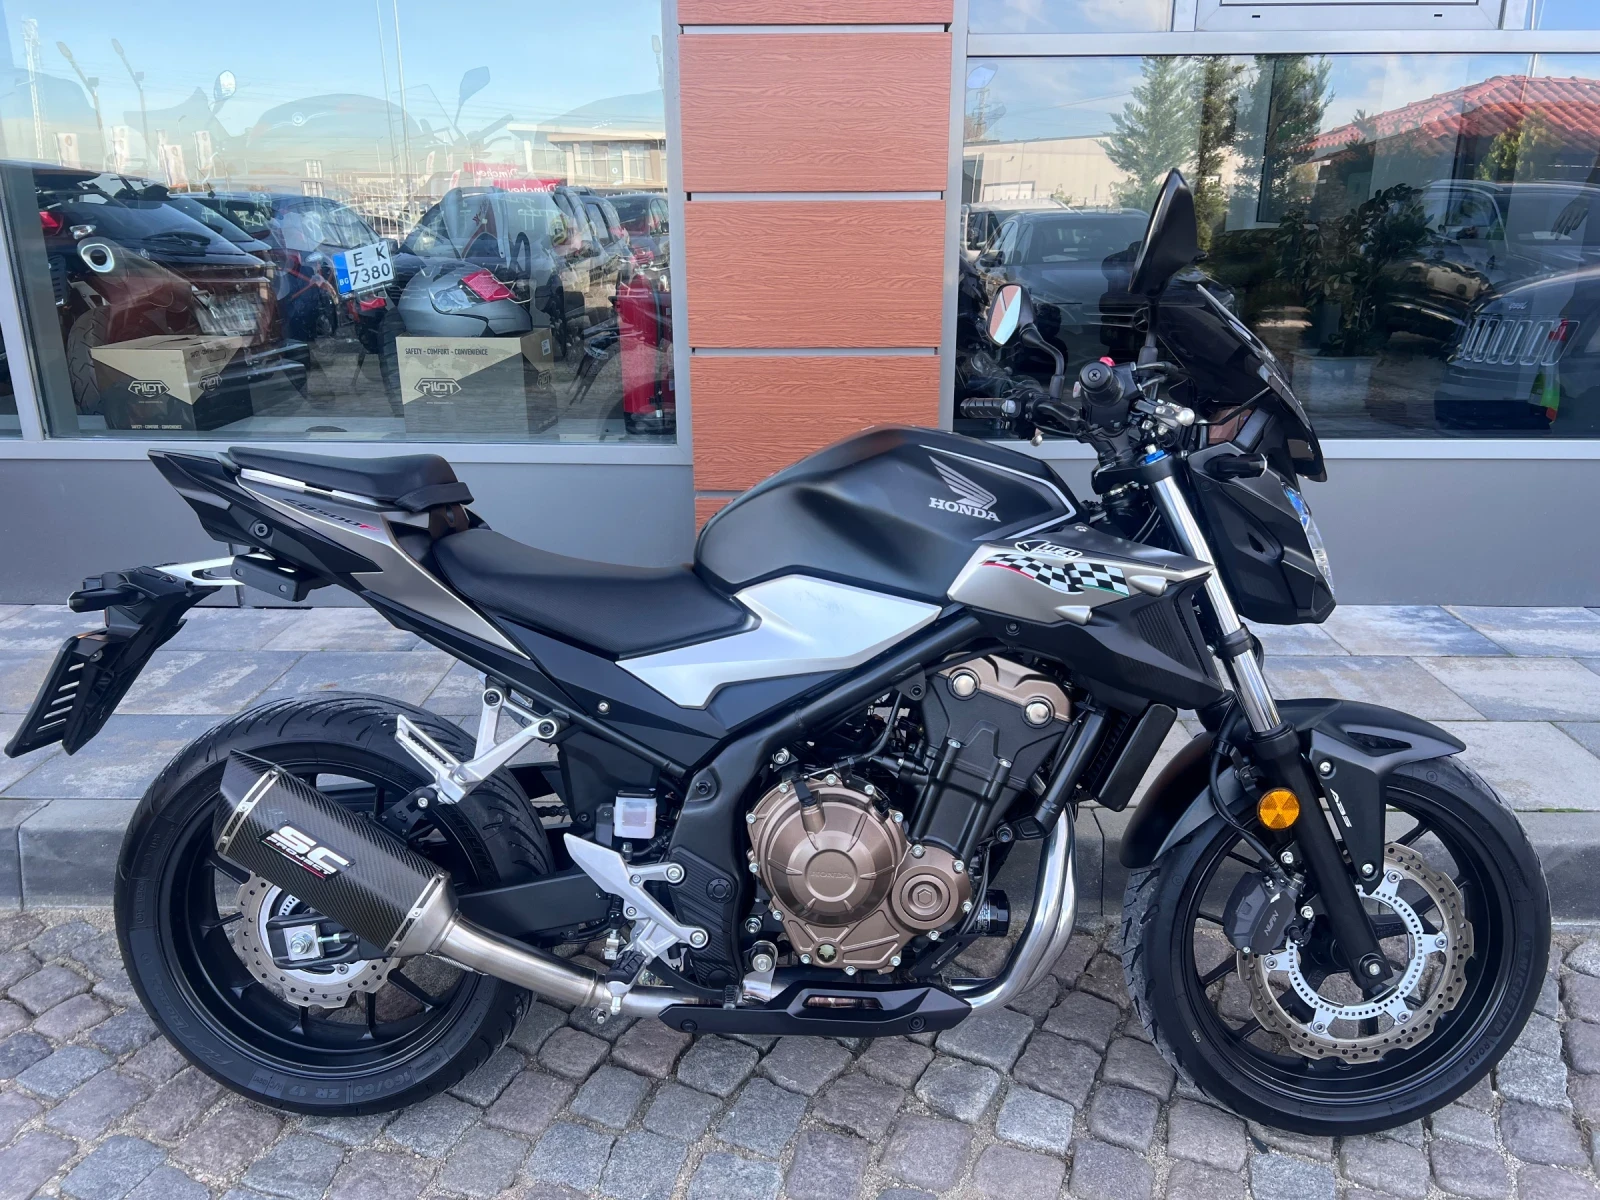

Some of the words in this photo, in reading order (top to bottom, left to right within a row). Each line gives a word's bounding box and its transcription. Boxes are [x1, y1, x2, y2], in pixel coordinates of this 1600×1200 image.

[353, 252, 364, 267] E
[376, 245, 387, 261] K
[339, 277, 350, 286] BG
[350, 262, 390, 286] 7380
[426, 348, 449, 356] COMFORT
[454, 348, 488, 356] CONVENIENCE
[928, 496, 1001, 522] HONDA
[1330, 788, 1353, 828] ABS
[266, 836, 334, 875] PROJECT
[270, 826, 350, 874] SC
[811, 871, 853, 880] HONDA
[1493, 958, 1530, 1035] MICHELIN
[1467, 1042, 1491, 1066] ROAD
[289, 1085, 307, 1098] 17
[315, 1087, 340, 1099] ZR
[354, 1071, 411, 1098] 160/60
